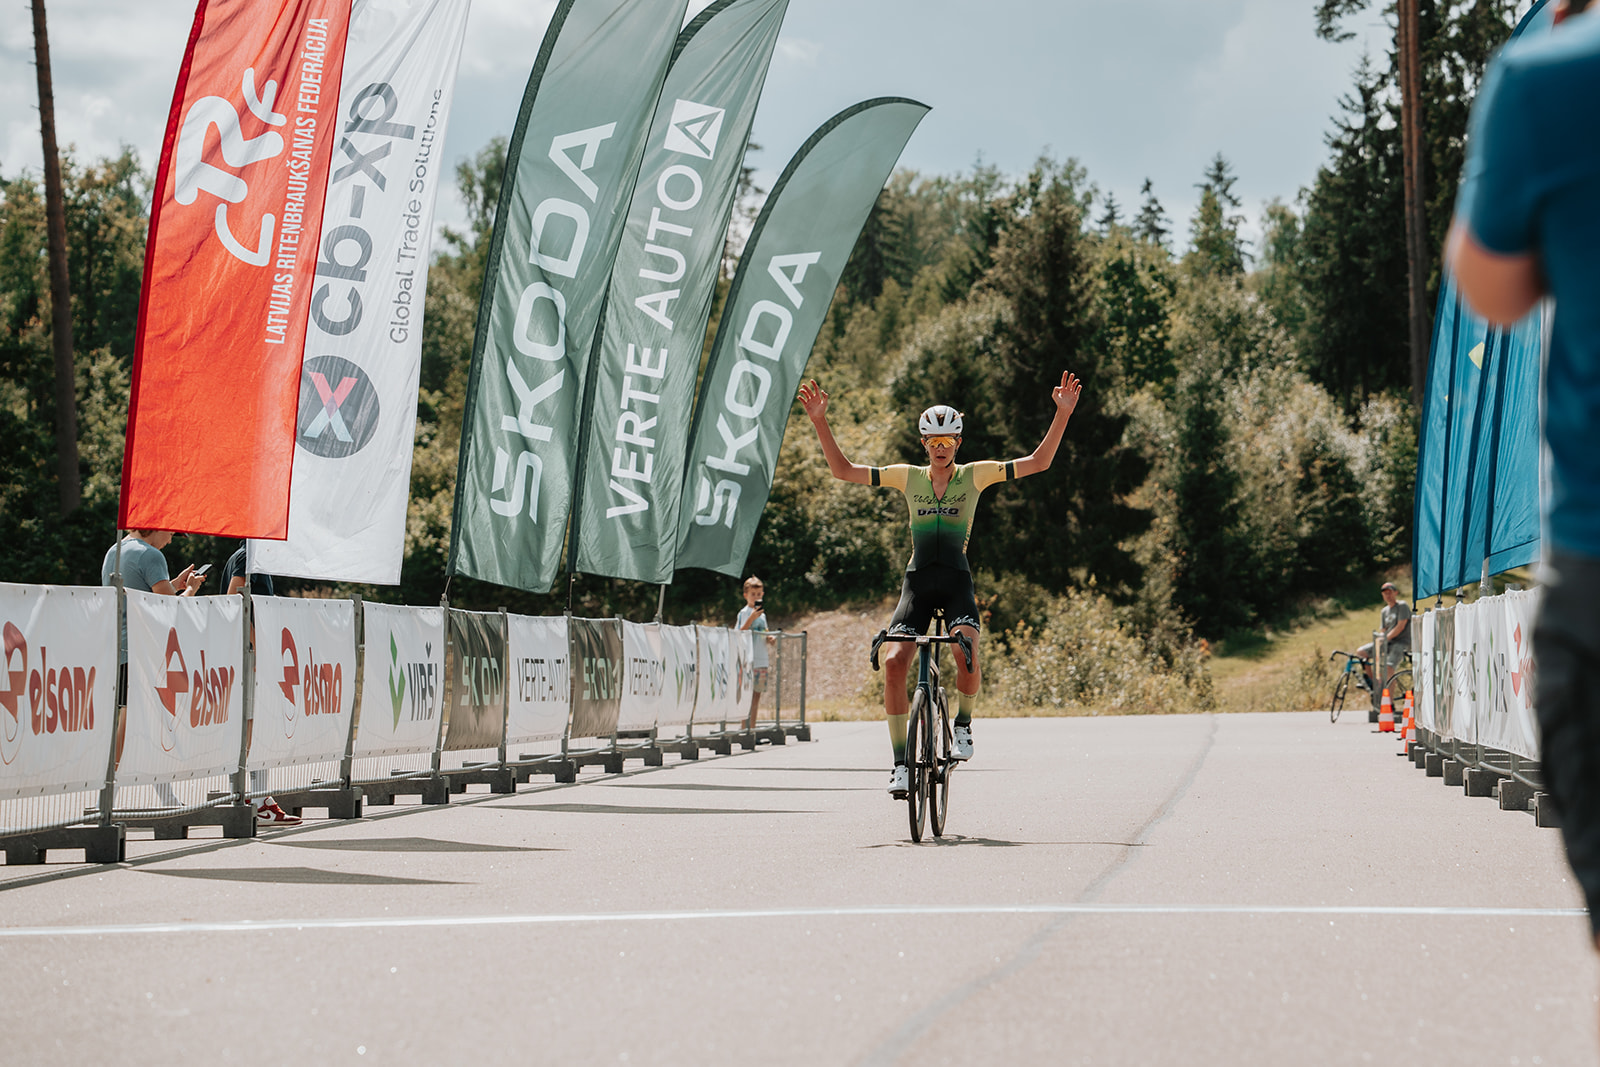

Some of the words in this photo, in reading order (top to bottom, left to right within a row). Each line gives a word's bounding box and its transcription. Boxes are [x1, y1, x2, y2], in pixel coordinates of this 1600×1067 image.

[299, 18, 329, 115] FEDERĀCIJA
[277, 117, 317, 269] RITEŅBRAUKŠANAS
[310, 82, 415, 336] cb-xp
[397, 200, 423, 271] Trade
[634, 164, 703, 331] AUTO
[265, 271, 293, 345] LATVIJAS
[390, 275, 414, 344] Global
[606, 343, 668, 519] VERTE
